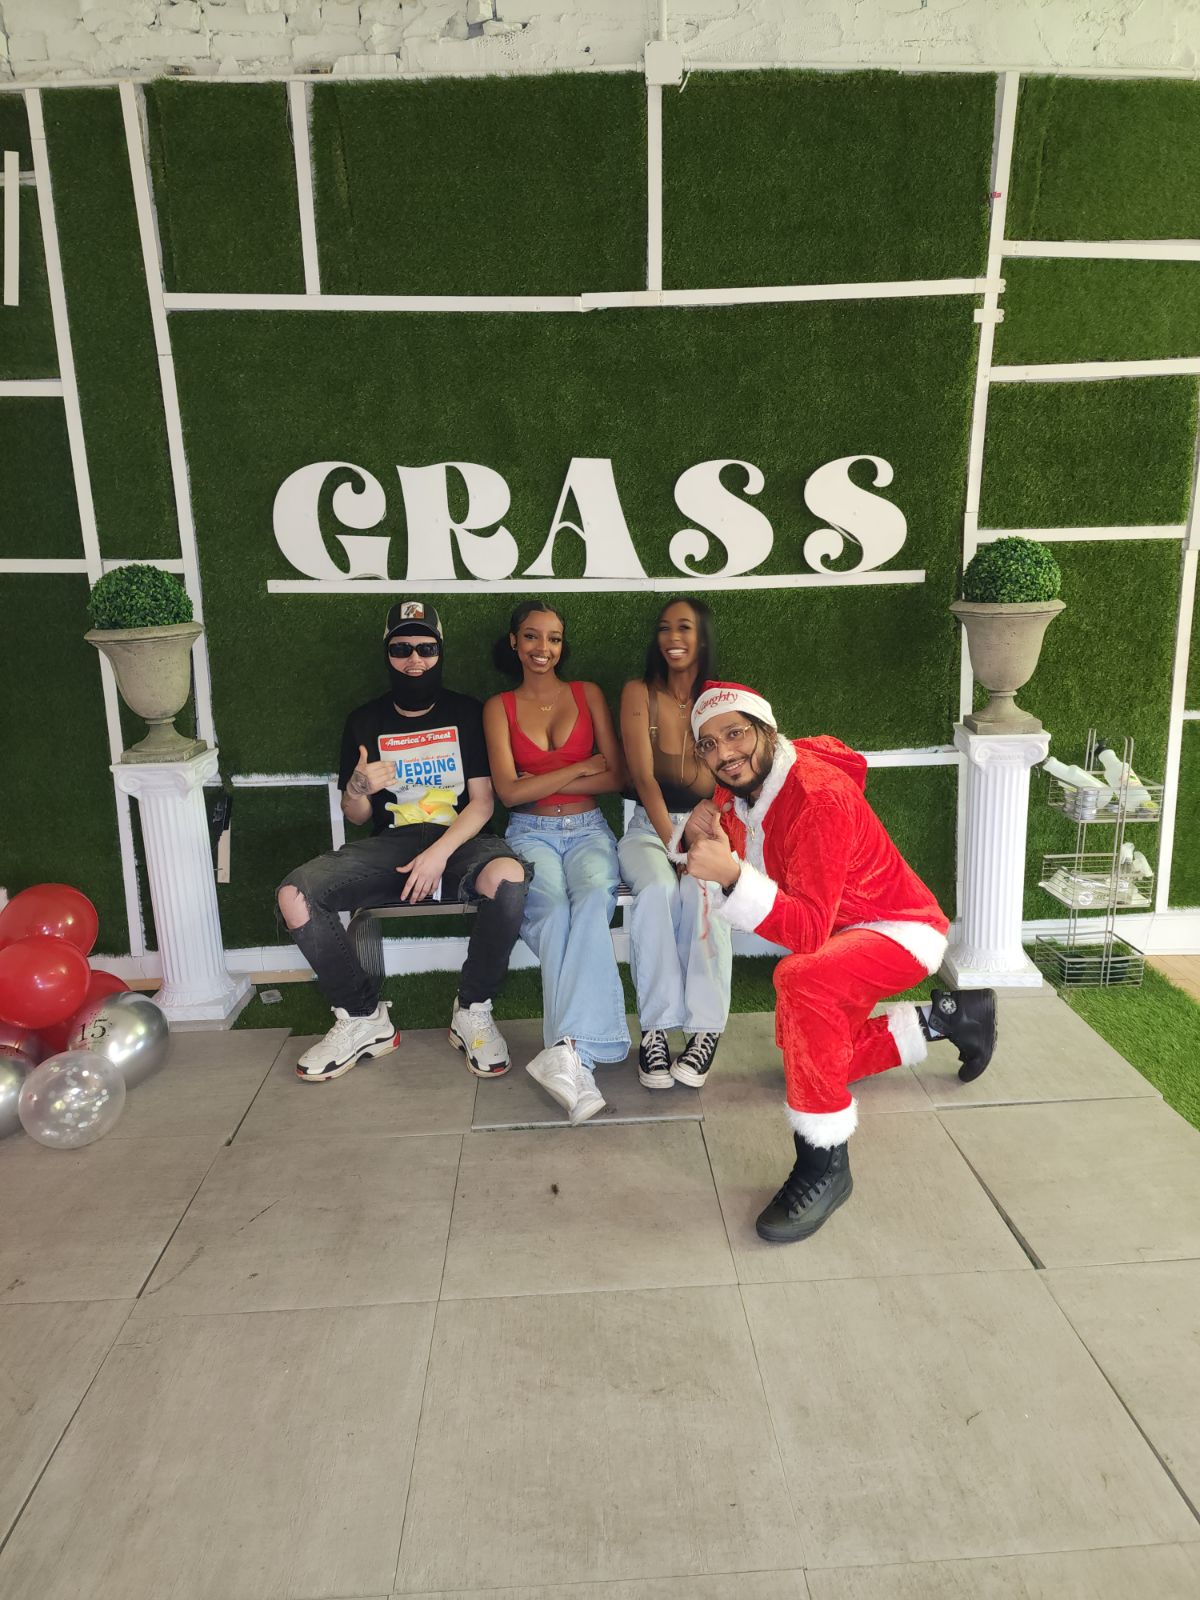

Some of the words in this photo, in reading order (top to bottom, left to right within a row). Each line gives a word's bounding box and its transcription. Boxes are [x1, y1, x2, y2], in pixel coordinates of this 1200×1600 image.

[272, 454, 908, 581] GRASS
[385, 735, 426, 747] America's
[426, 731, 452, 741] Finest
[80, 1019, 108, 1041] 15
